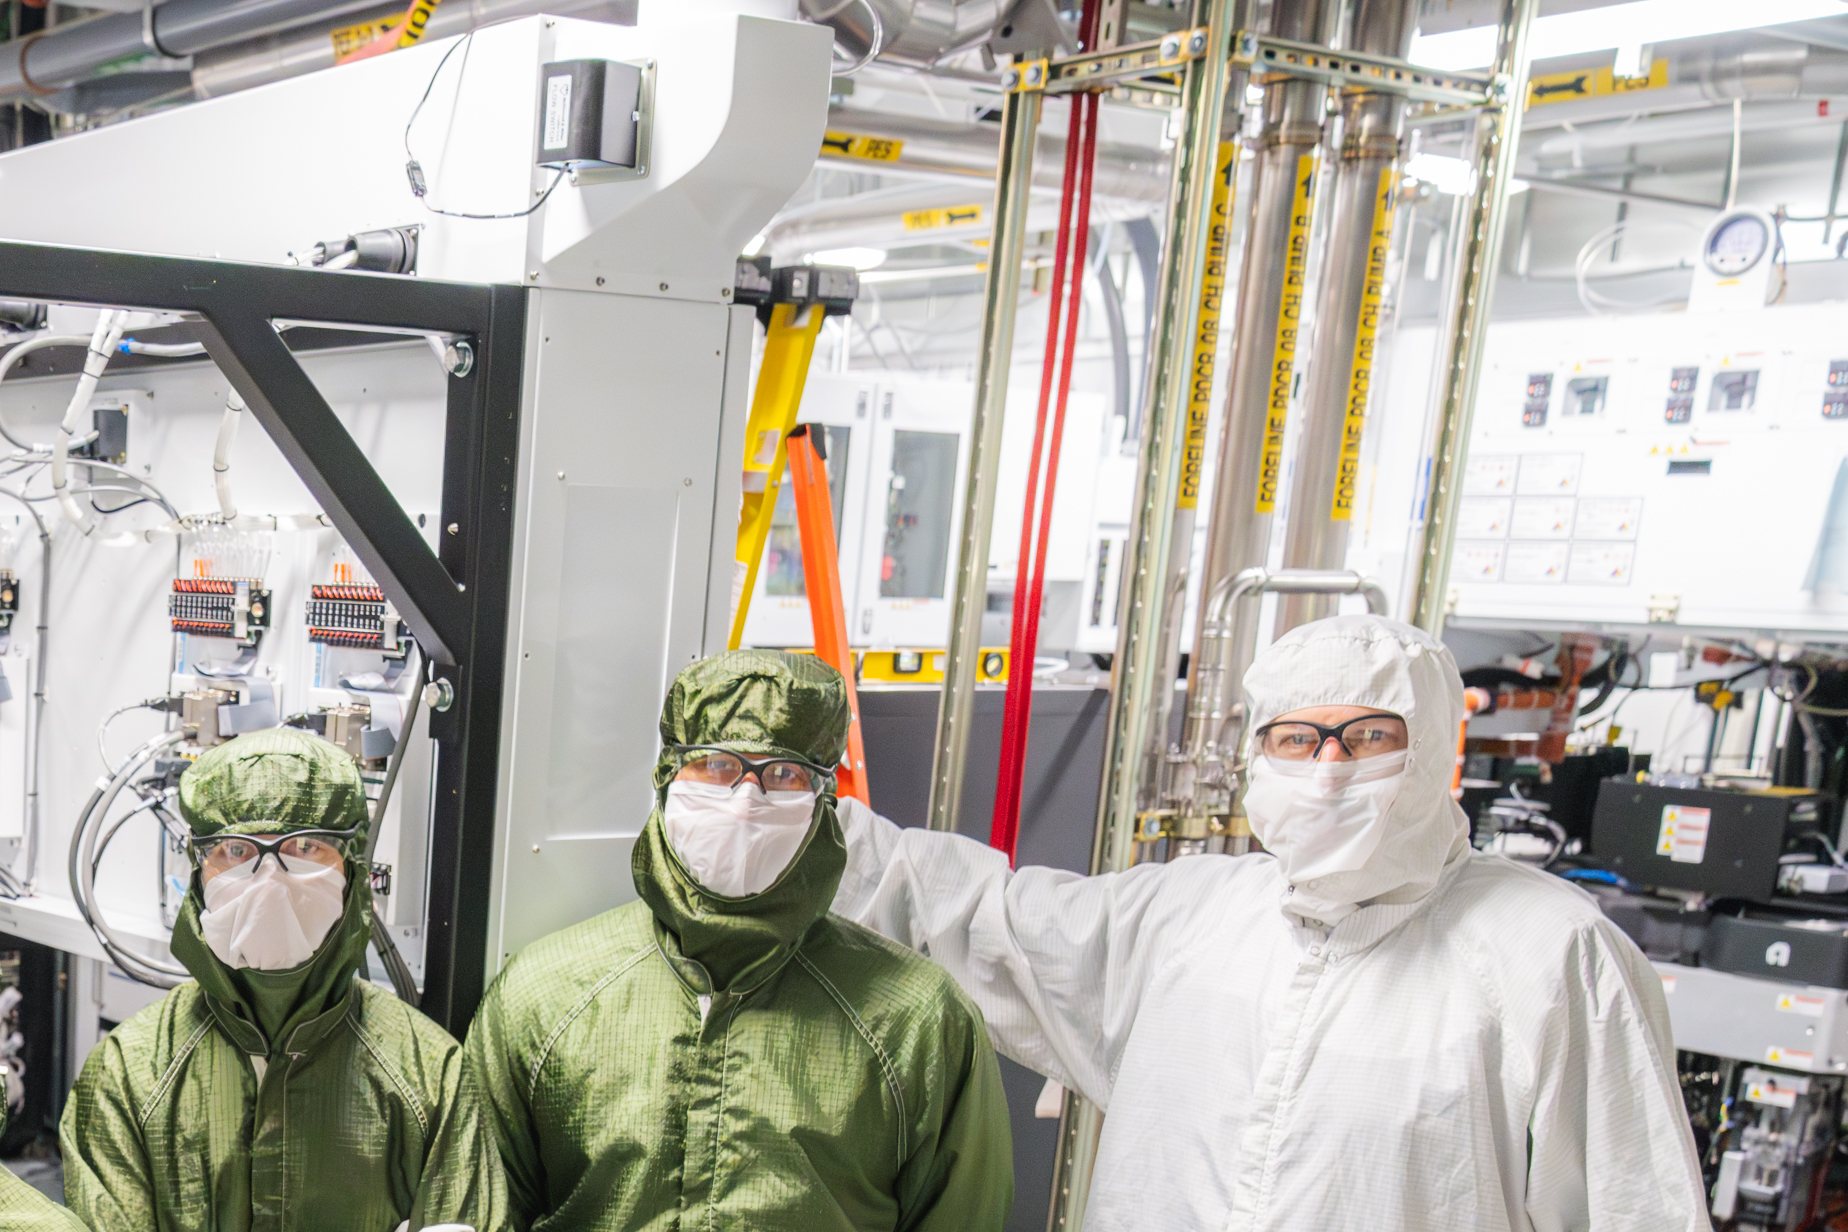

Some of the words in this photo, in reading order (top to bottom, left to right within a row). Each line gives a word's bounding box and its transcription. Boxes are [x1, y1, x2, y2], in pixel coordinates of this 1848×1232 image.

[1208, 224, 1229, 276] PUMP
[1288, 234, 1308, 285] PUMP
[1367, 246, 1386, 295] PUMP
[1204, 284, 1222, 311] CH
[1284, 293, 1301, 320] CH
[1363, 303, 1379, 328] CH
[1184, 409, 1207, 497] FORELINE
[1261, 416, 1284, 502] FORELINE
[1337, 424, 1360, 509] FORELINE
